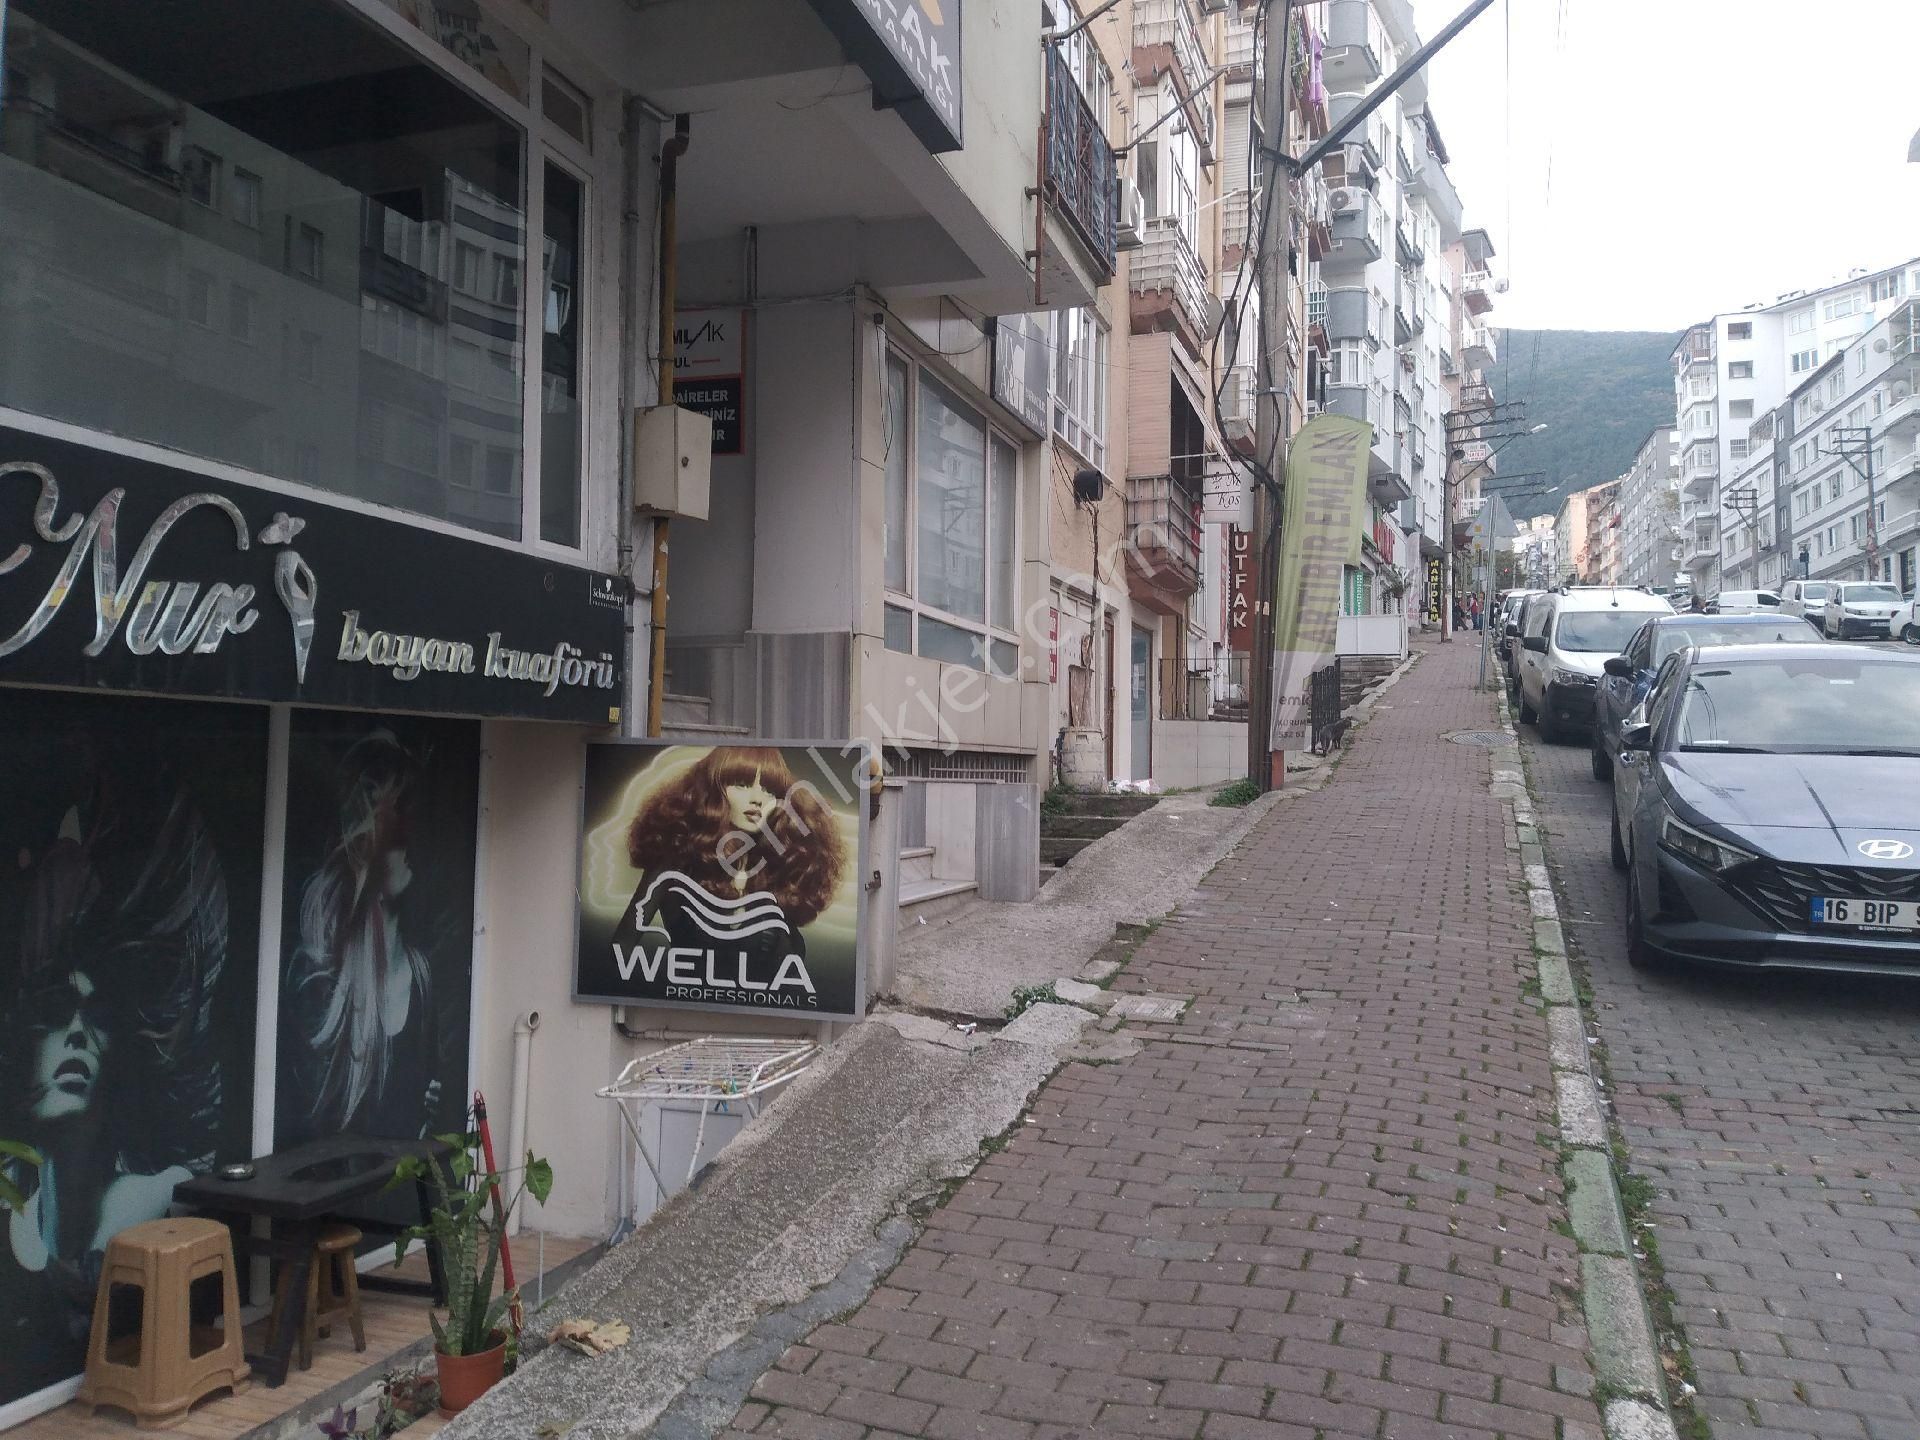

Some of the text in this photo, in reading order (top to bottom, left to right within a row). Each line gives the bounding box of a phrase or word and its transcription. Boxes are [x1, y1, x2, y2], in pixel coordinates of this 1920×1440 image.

[672, 390, 729, 404] AİRELER
[337, 609, 614, 697] bayan kuaförü
[1825, 900, 1849, 922] 16
[1863, 901, 1900, 925] BIP
[612, 943, 817, 994] WELLA
